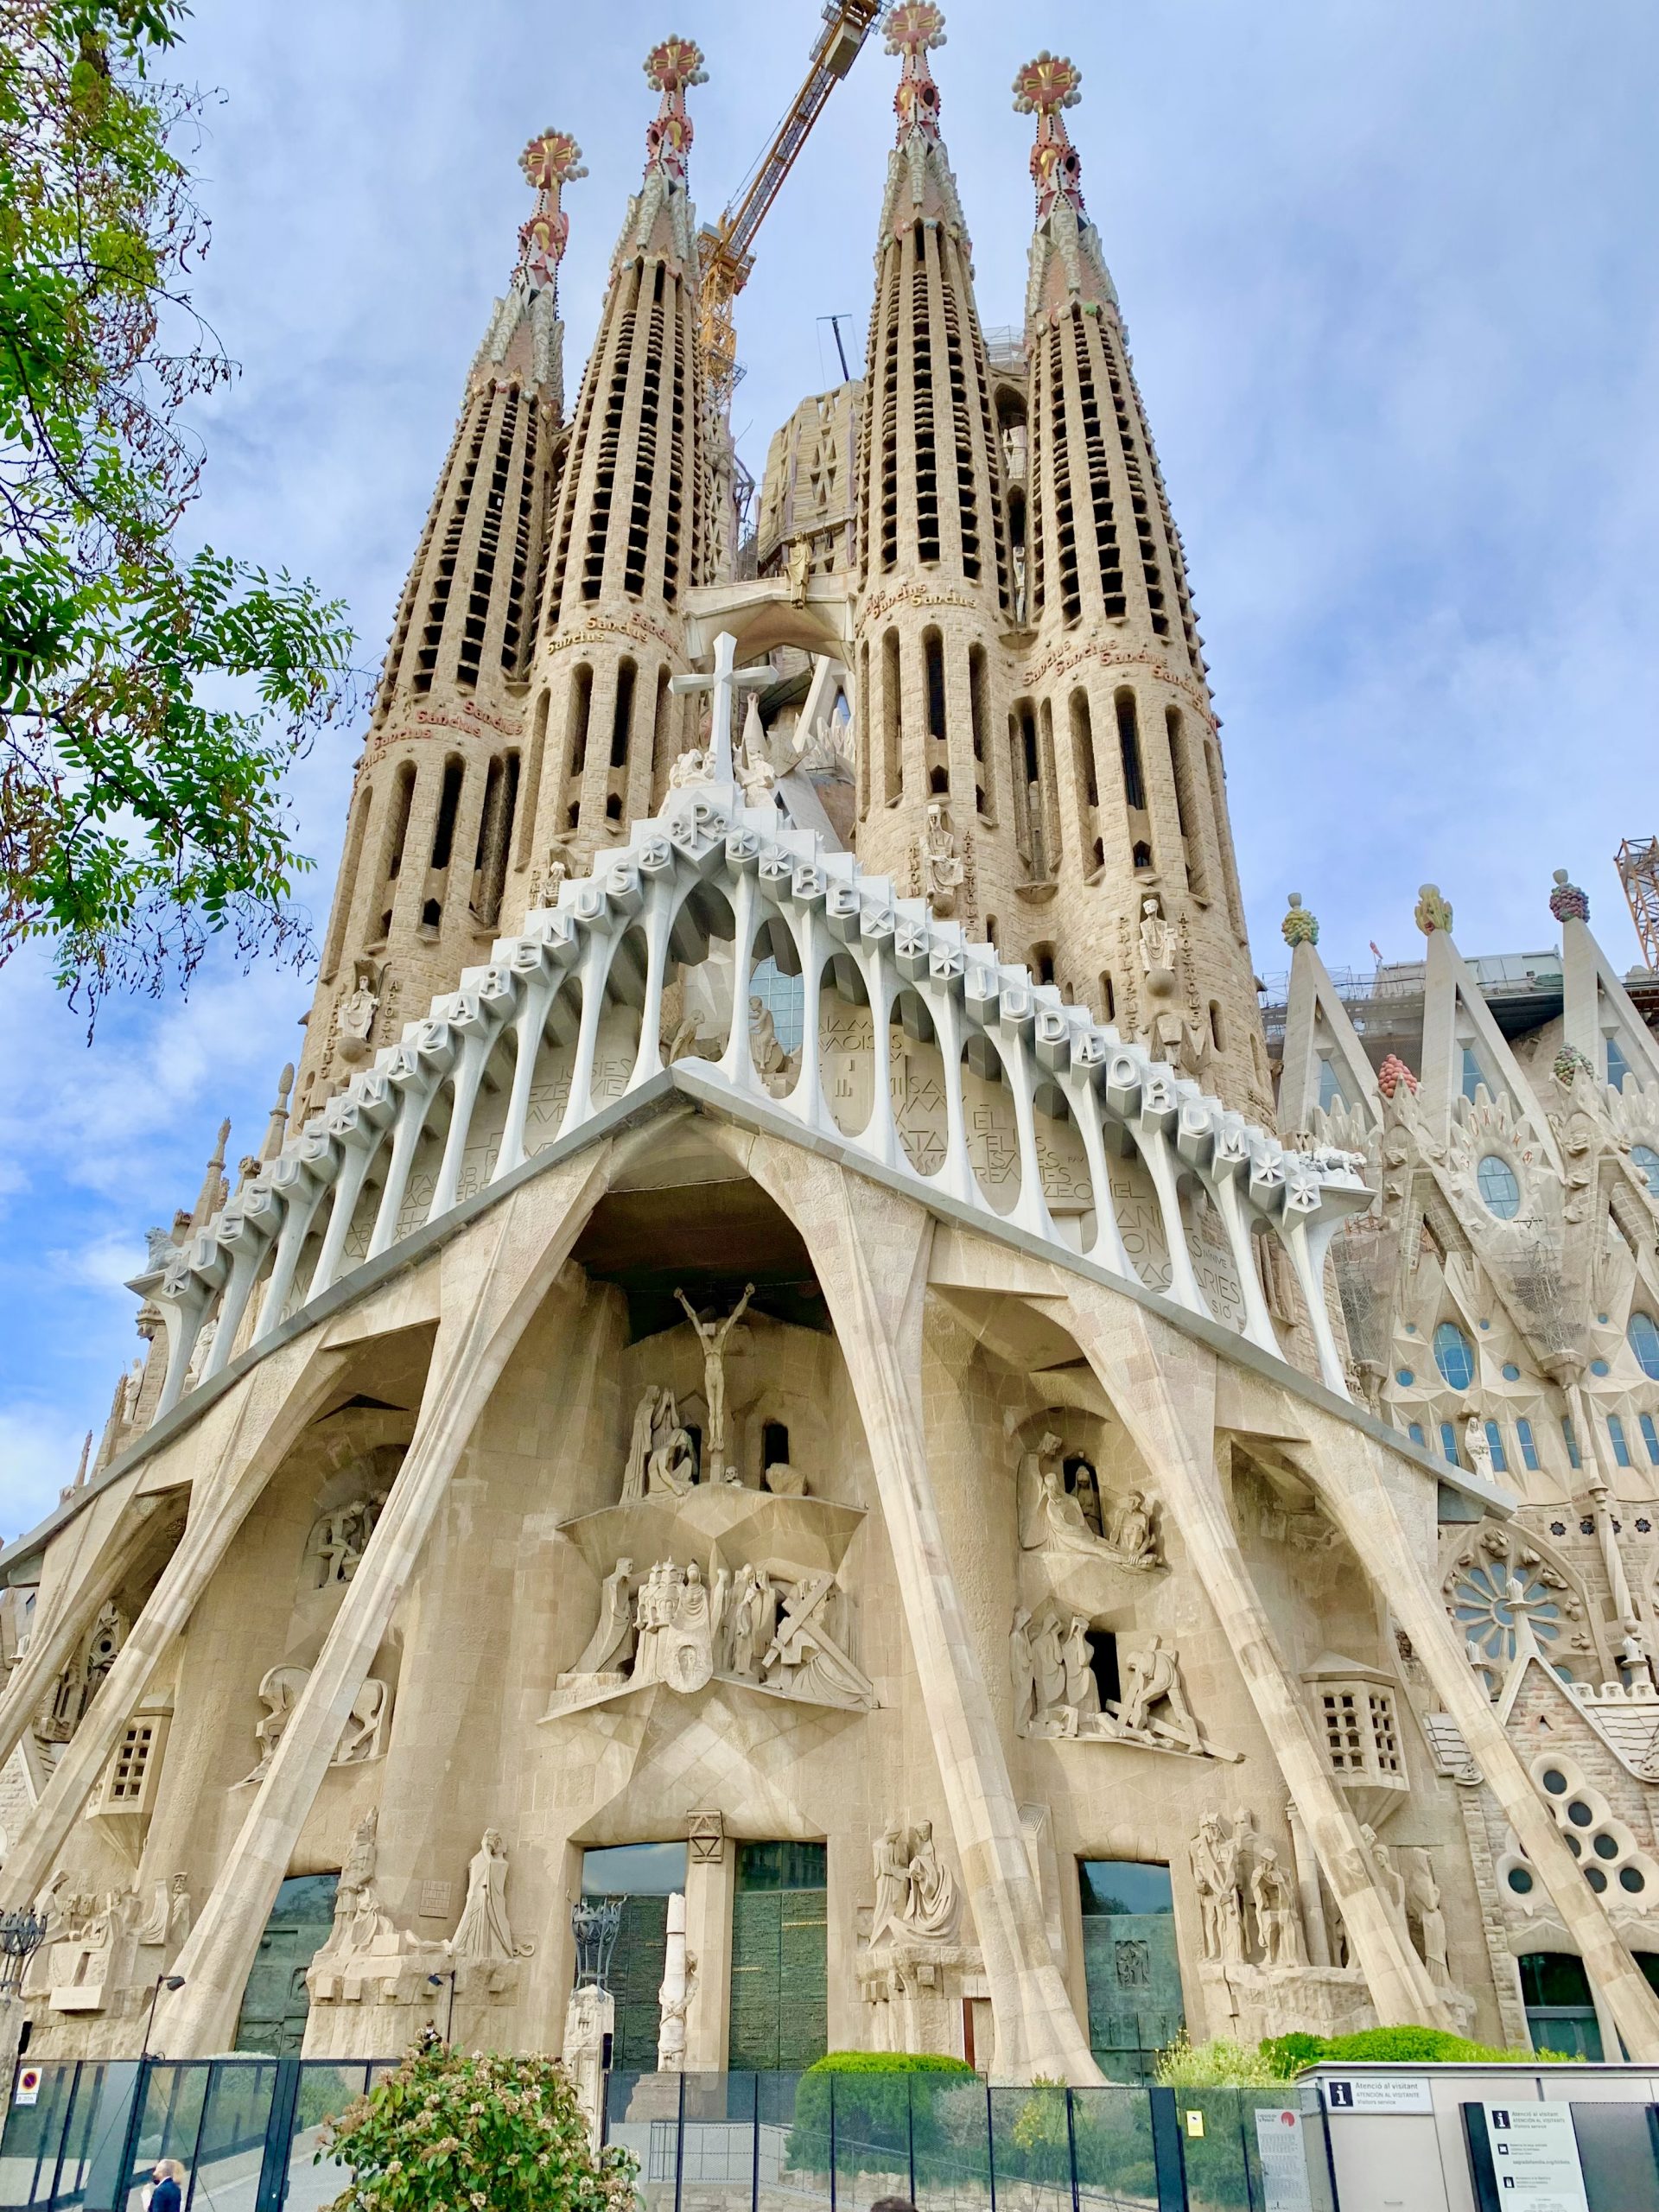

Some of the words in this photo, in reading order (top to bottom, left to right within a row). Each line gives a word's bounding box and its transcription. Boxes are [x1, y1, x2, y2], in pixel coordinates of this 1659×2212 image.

[910, 588, 976, 608] Sanctus
[546, 631, 606, 655] Sanctus
[586, 614, 649, 643] Sanctus
[416, 709, 483, 738] Sanctus
[463, 700, 524, 734] Sanctus
[373, 727, 432, 750] Sanctus
[358, 861, 632, 1102] NAZARENUS
[797, 864, 892, 934] REX
